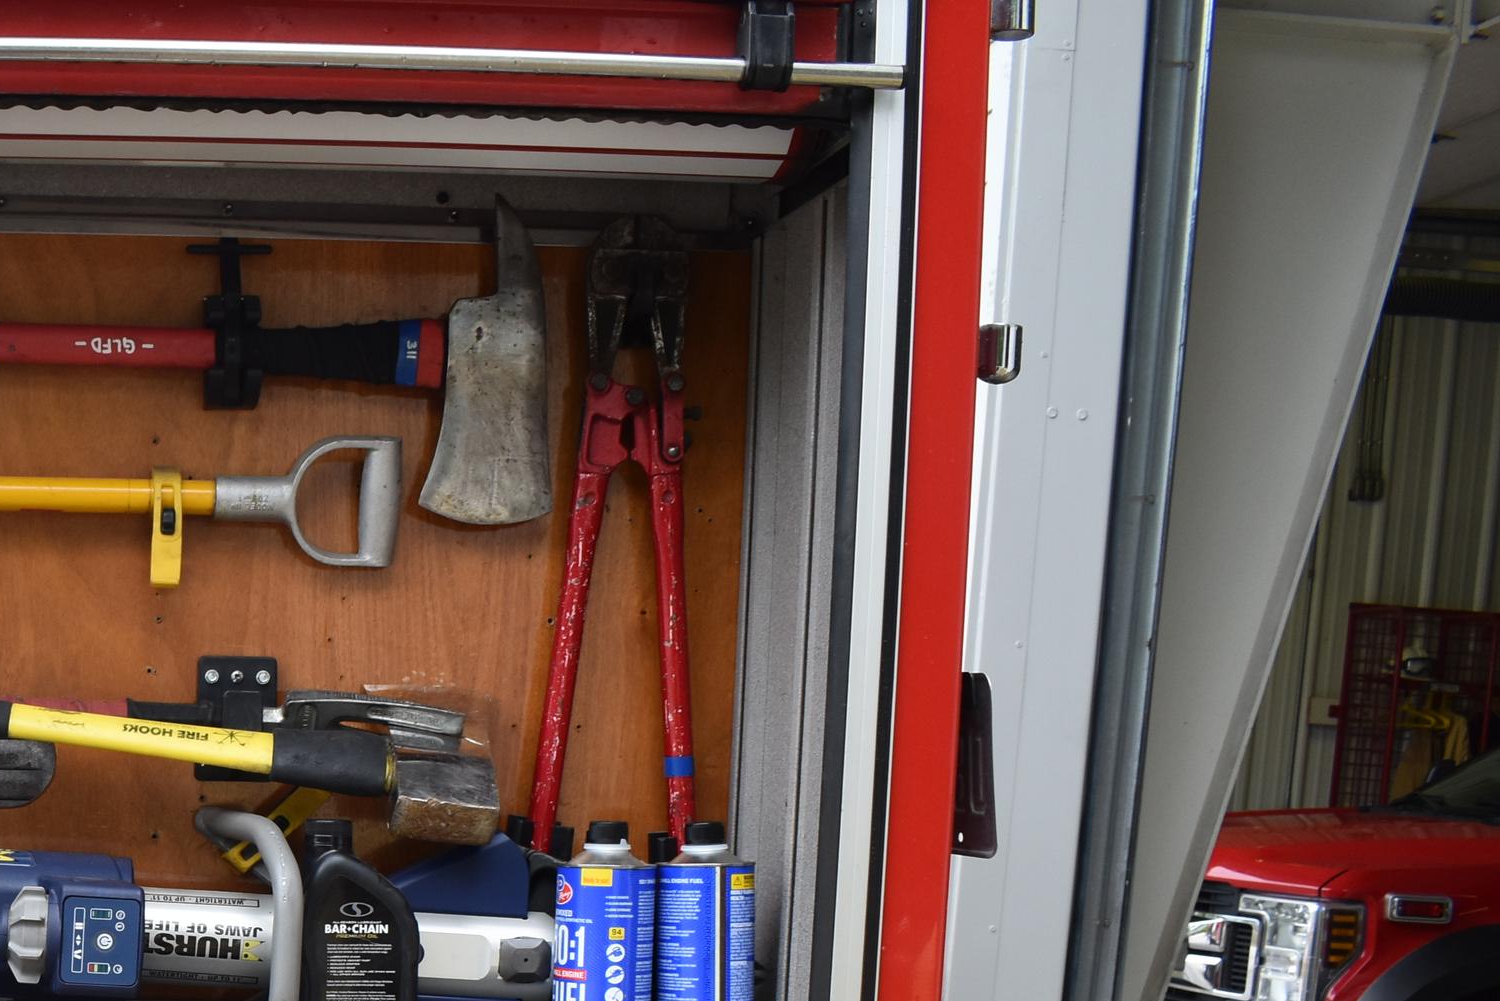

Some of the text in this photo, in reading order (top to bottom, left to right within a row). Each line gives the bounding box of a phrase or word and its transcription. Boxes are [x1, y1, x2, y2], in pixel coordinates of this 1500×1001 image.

[91, 337, 135, 354] GLFD
[122, 723, 209, 742] FIRE HOOKS
[195, 897, 244, 905] WATERTIGHT
[145, 920, 263, 938] JAWS OF LIFE
